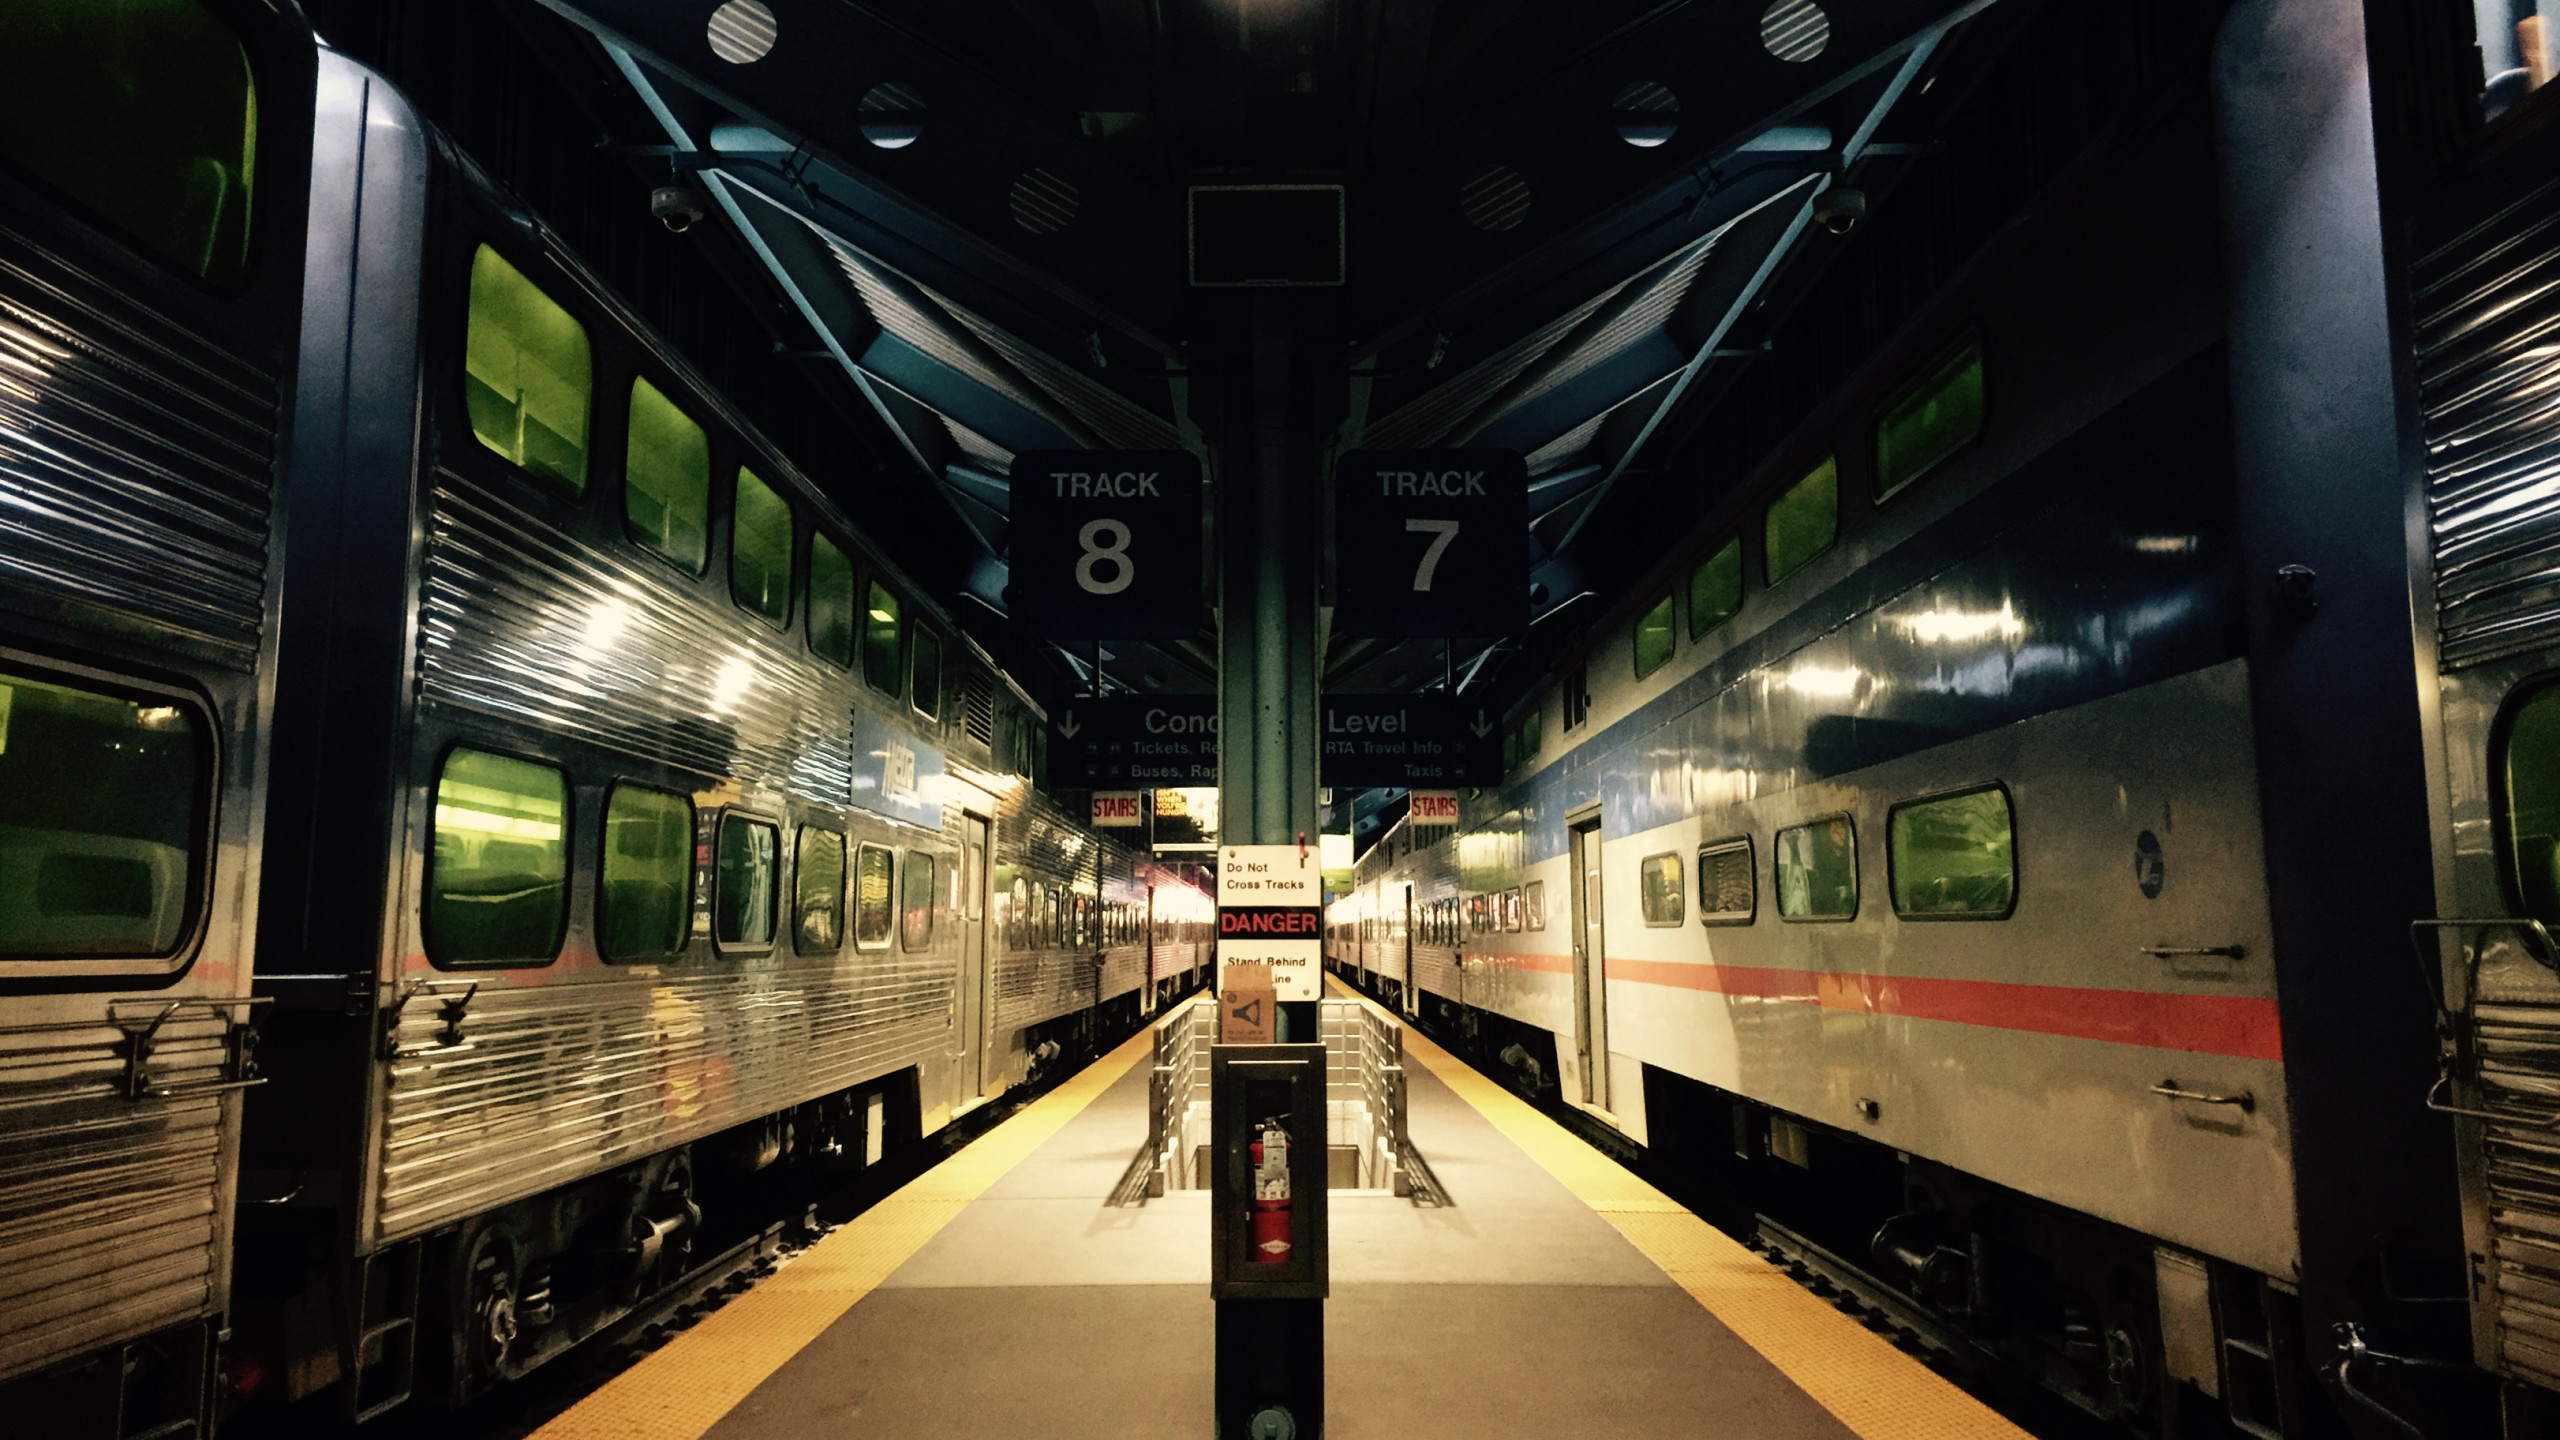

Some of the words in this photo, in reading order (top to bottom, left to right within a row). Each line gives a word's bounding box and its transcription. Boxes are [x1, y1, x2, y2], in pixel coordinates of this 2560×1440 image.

[1050, 472, 1160, 498] TRACK
[1376, 470, 1486, 496] TRACK
[1075, 518, 1135, 595] 8
[1405, 518, 1459, 592] 7
[1328, 709, 1407, 734] Level
[1132, 741, 1193, 755] Tickets,
[1326, 741, 1356, 754] RTA
[1362, 741, 1406, 754] Travel
[1413, 741, 1443, 754] Info
[1131, 764, 1184, 778] Buses,
[1403, 764, 1443, 777] Taxis
[1093, 798, 1137, 817] STAIRS
[1413, 797, 1457, 816] STAIRS
[1226, 862, 1243, 873] Do
[1247, 862, 1268, 873] Not
[1226, 879, 1261, 890] Cross
[1265, 879, 1305, 890] Tracks
[1220, 912, 1318, 933] DANGER
[1227, 956, 1262, 966] Stand
[1267, 957, 1306, 966] Behind
[1271, 974, 1292, 984] ine
[2470, 1252, 2486, 1302] F
